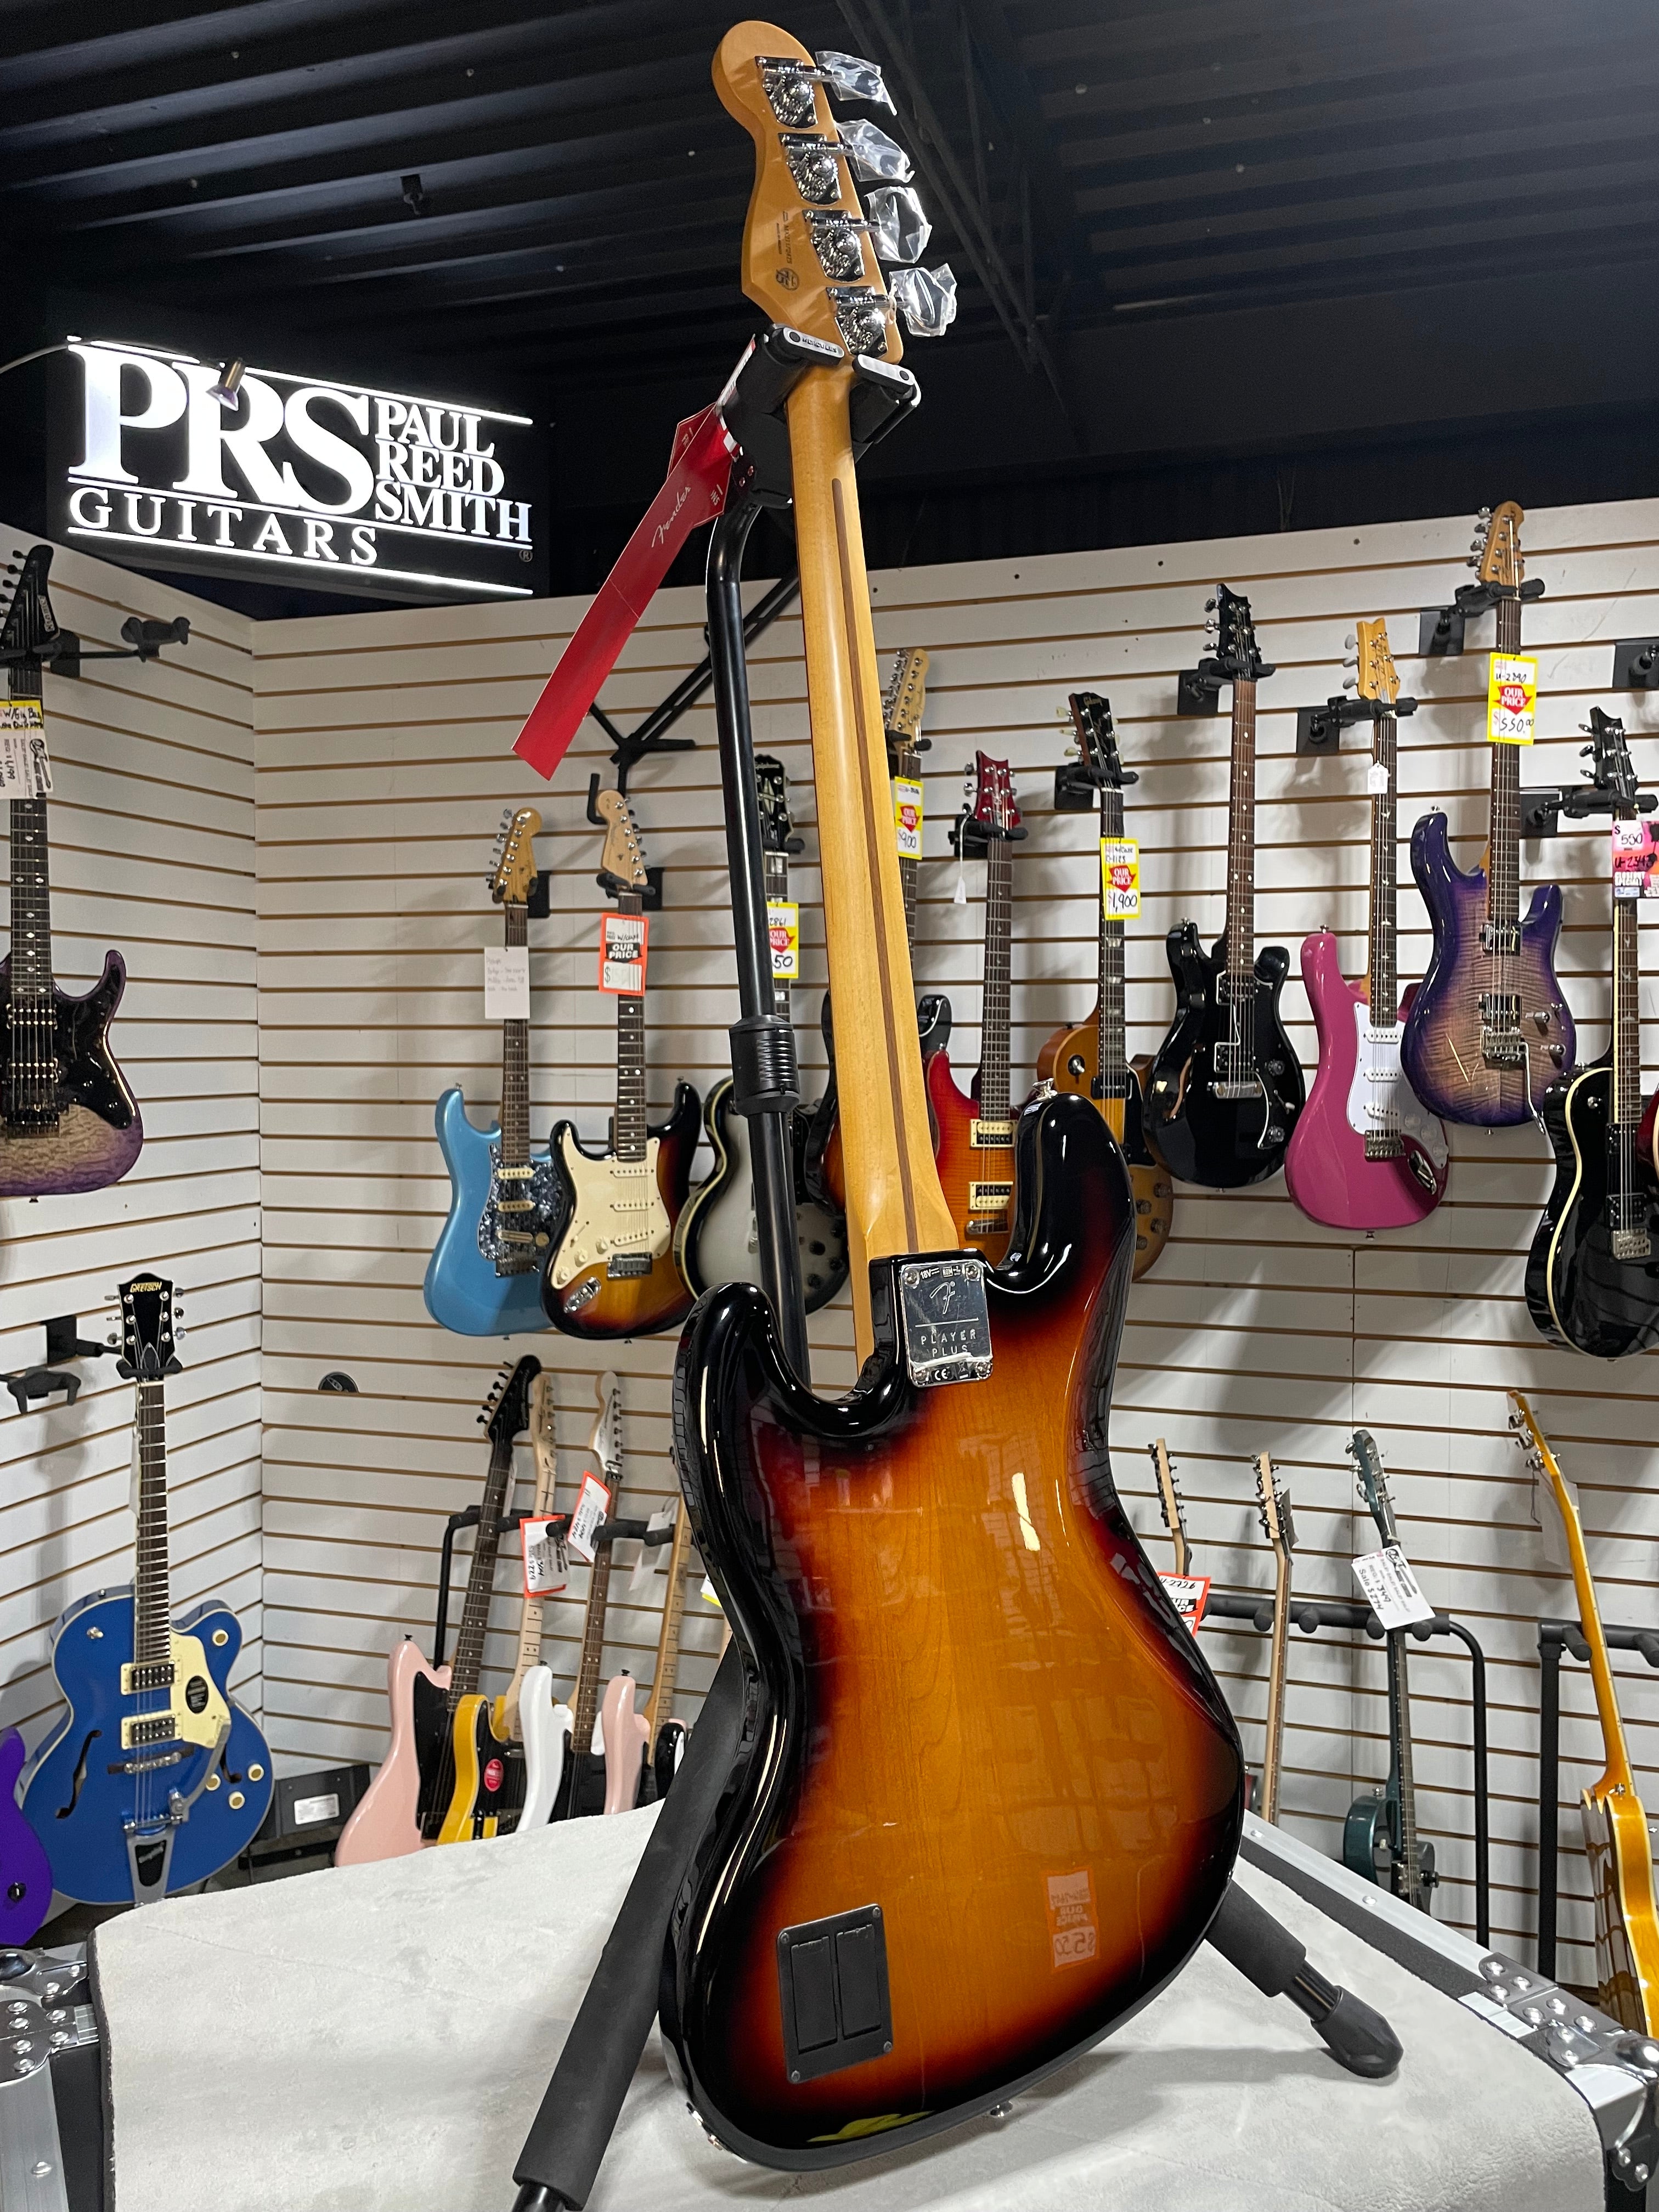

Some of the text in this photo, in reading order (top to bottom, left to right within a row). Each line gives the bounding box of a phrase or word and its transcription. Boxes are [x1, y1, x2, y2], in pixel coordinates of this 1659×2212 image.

[68, 345, 374, 515] PRS
[374, 396, 494, 459] PAUL
[374, 439, 505, 497] REED
[375, 481, 533, 543] SMITH
[651, 486, 692, 548] Fender
[69, 487, 378, 566] GUITARS
[1504, 687, 1523, 698] OUR
[1501, 696, 1526, 708] PRICE
[1114, 868, 1130, 877] OUR
[1113, 876, 1132, 886] PRICE
[770, 929, 787, 939] OUR
[612, 943, 634, 951] OUR
[609, 950, 639, 959] PRICE
[129, 1281, 162, 1293] GRETSCH
[921, 1329, 976, 1345] PLAYER
[932, 1344, 968, 1358] PLUS
[1359, 1568, 1370, 1587] Sale
